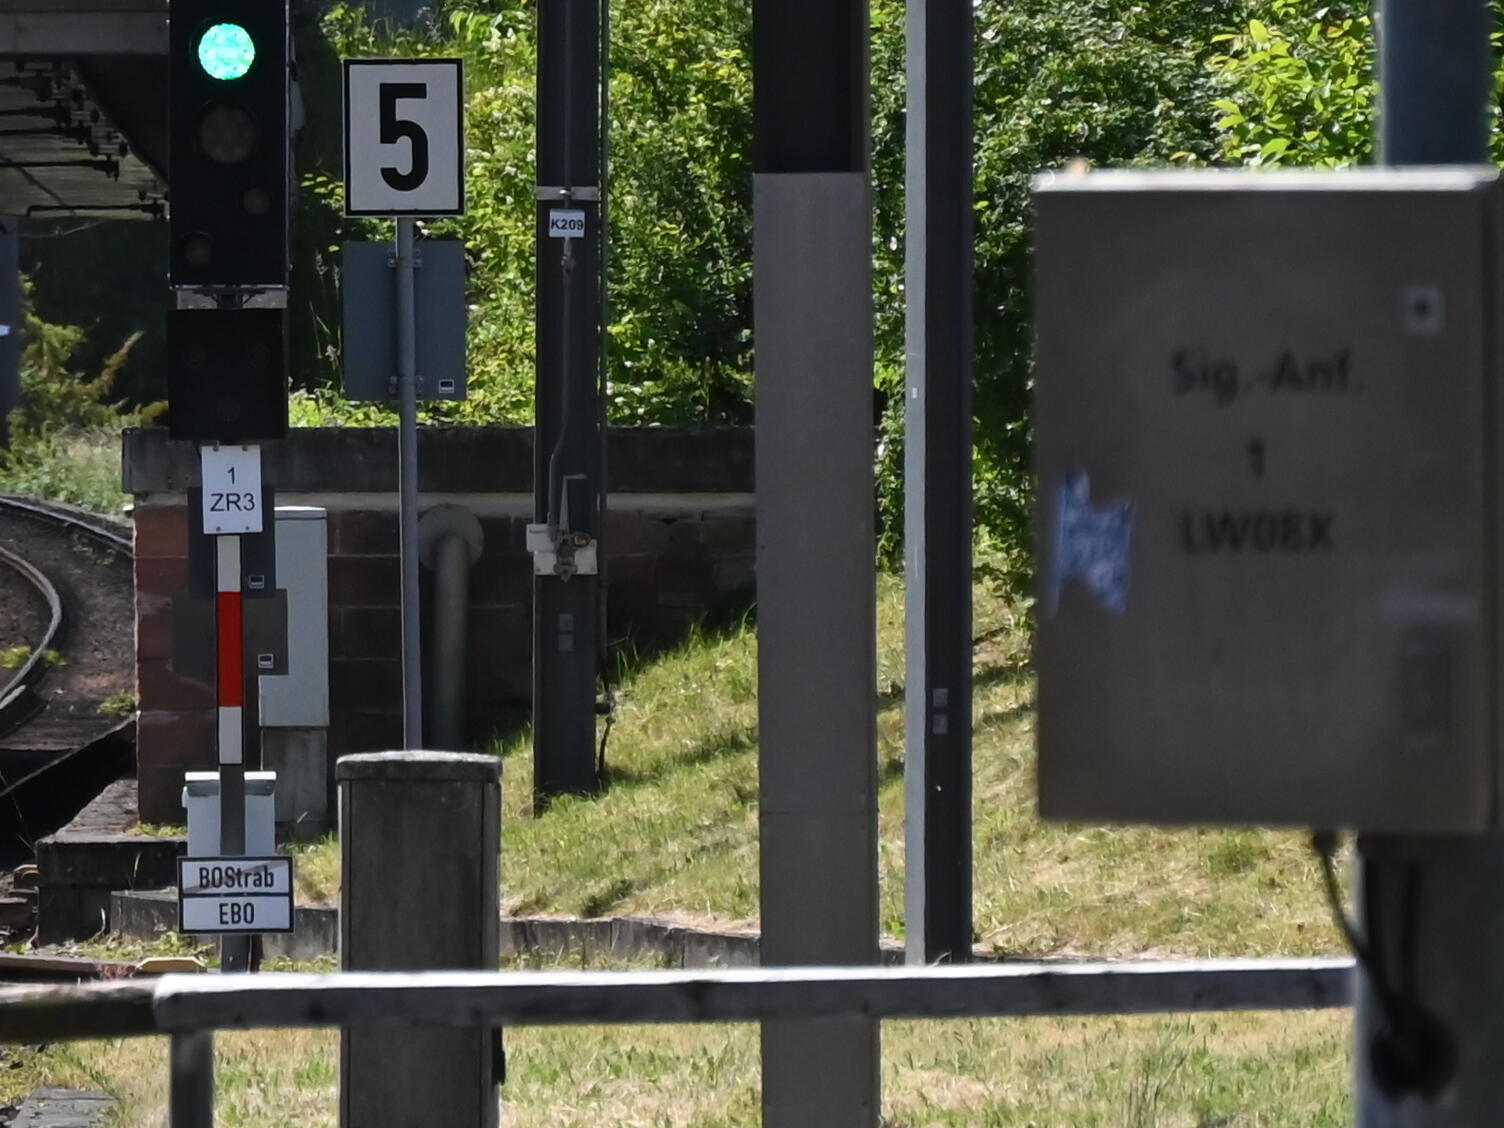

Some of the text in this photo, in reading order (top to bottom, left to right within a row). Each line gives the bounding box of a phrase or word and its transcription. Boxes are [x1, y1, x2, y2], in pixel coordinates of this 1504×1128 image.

[379, 83, 429, 192] 5
[551, 218, 583, 230] K209
[227, 466, 235, 485] 1
[210, 492, 255, 512] ZR3
[199, 865, 274, 888] BOStrab
[219, 902, 255, 925] EBO
